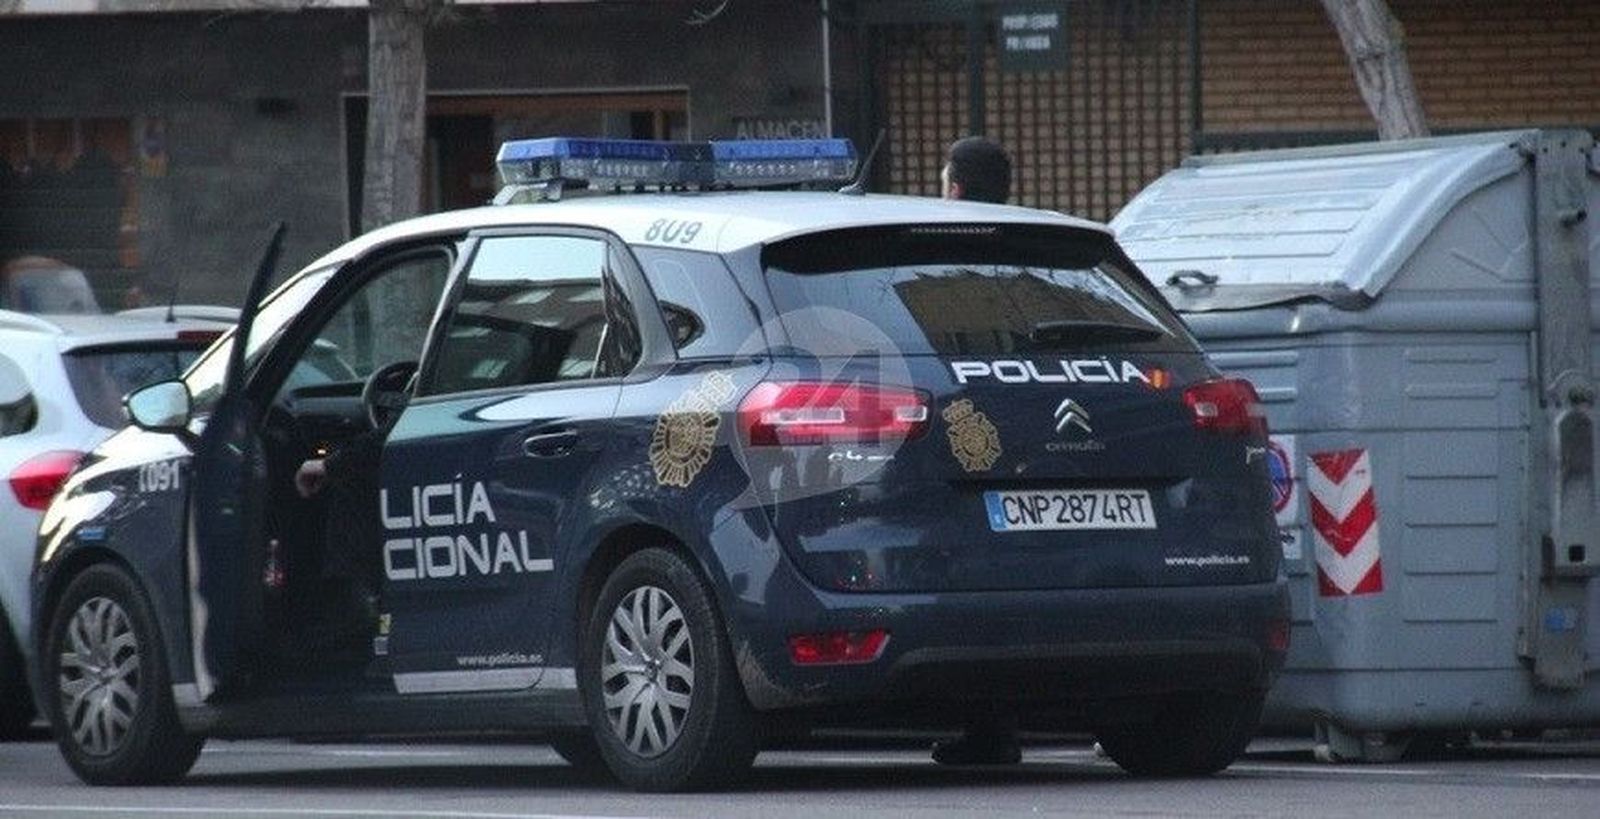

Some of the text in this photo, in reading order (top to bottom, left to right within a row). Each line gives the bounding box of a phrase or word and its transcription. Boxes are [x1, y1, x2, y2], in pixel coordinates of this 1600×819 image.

[951, 356, 1151, 384] POLICÍA
[379, 473, 496, 529] LICÍA
[383, 530, 554, 580] CIONAL
